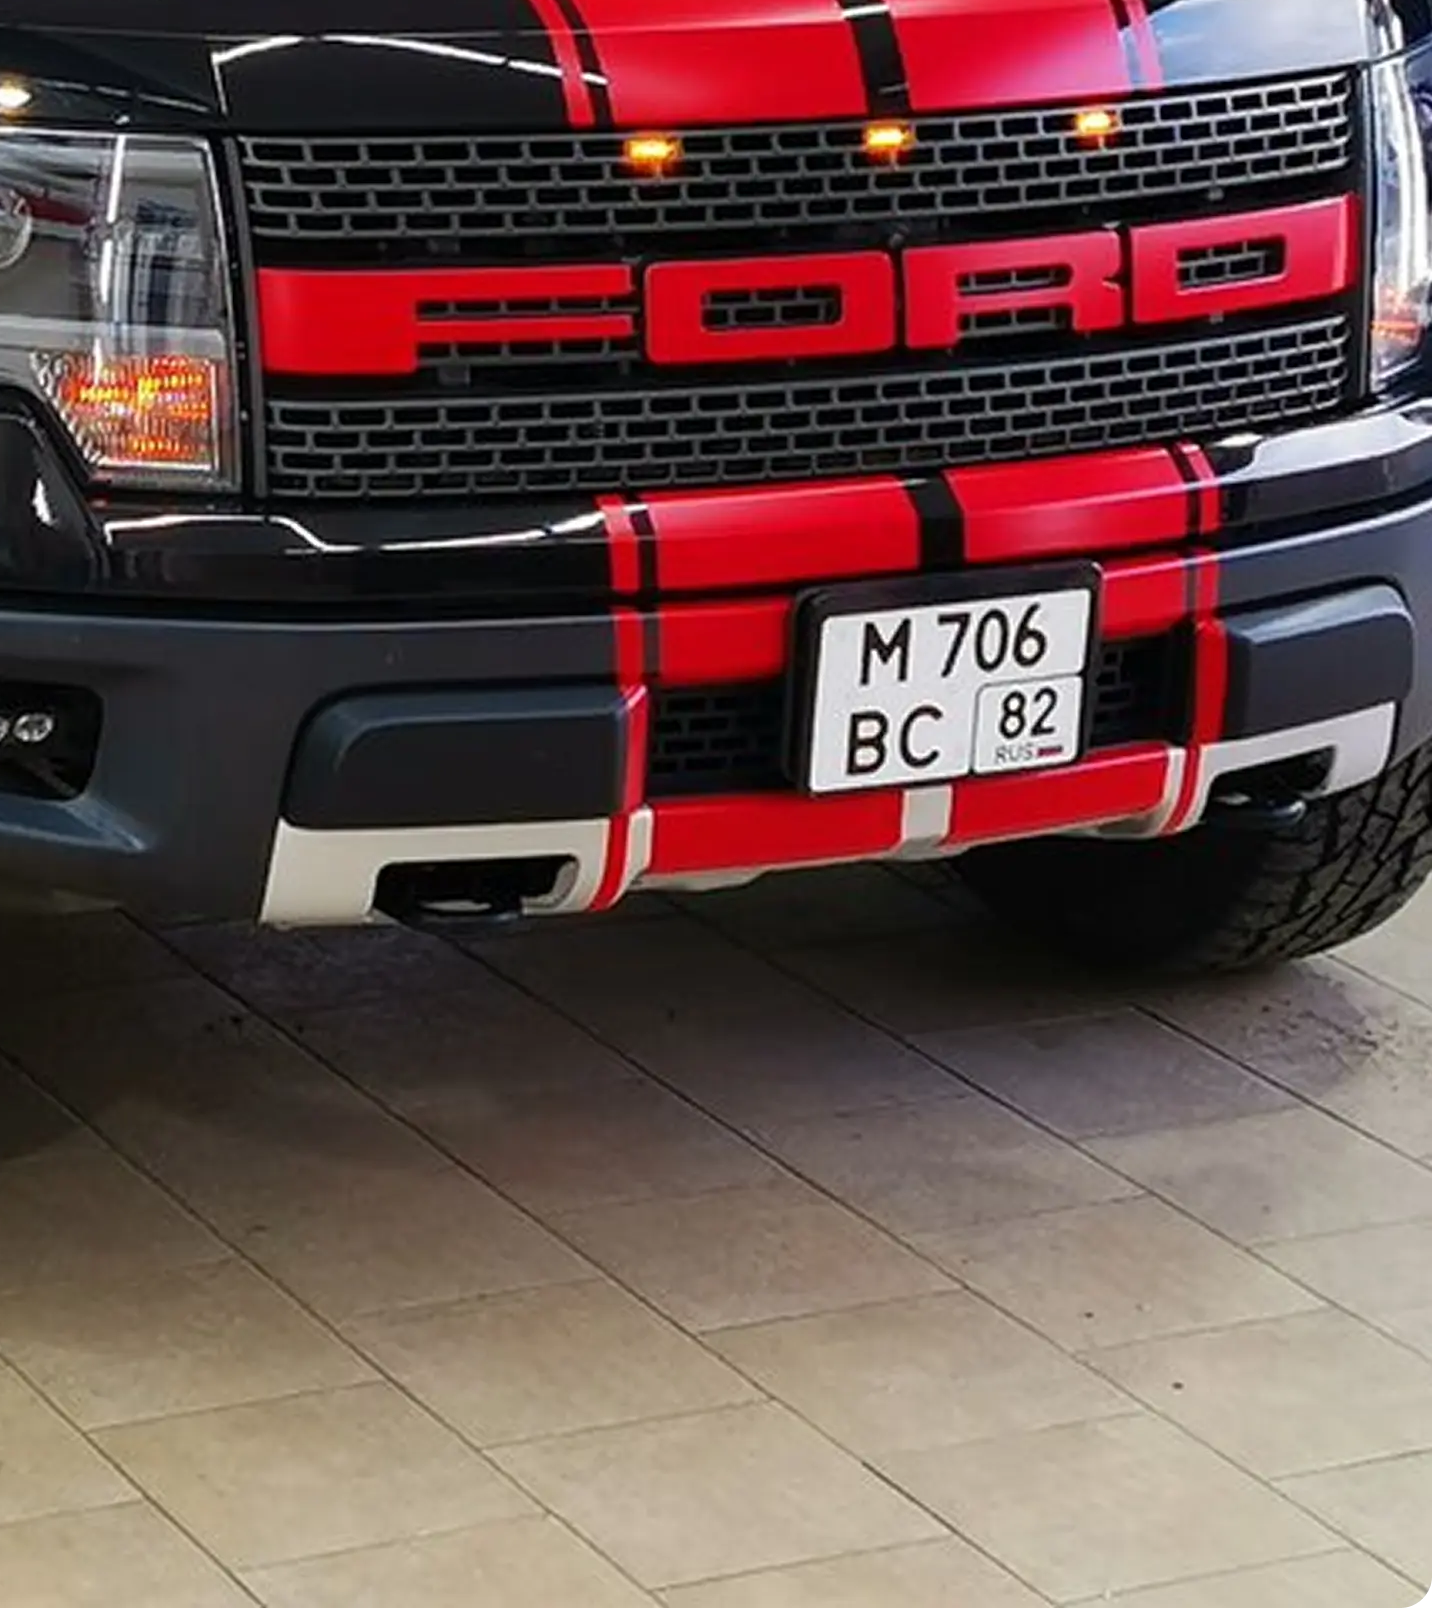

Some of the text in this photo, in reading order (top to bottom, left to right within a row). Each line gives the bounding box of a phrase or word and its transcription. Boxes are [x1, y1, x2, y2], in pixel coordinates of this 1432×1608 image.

[255, 193, 1356, 377] FORD
[860, 603, 1048, 686] M 706
[845, 687, 1058, 776] BC 82
[994, 742, 1035, 765] RUS
